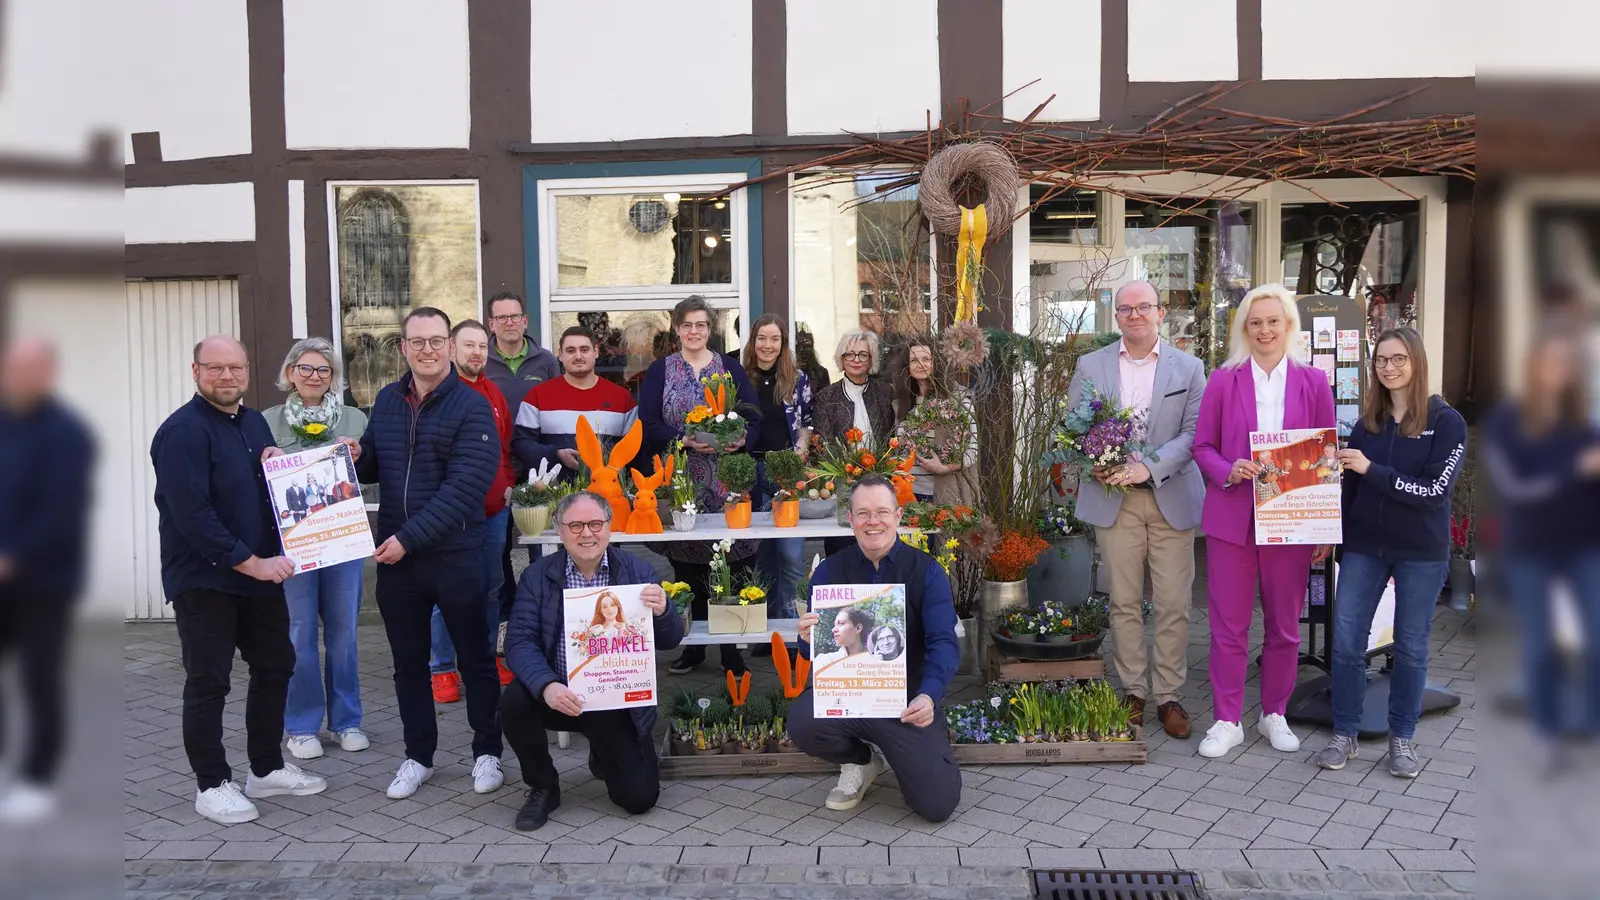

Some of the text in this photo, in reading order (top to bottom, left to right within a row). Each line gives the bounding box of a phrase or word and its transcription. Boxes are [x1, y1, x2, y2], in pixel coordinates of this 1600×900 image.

[1252, 433, 1291, 444] BRAKEL
[265, 455, 306, 472] BRAKEL
[307, 515, 335, 526] Stereo
[336, 507, 364, 519] Naked
[1258, 512, 1290, 520] Dienstag,
[286, 536, 319, 548] Samstag,
[320, 532, 331, 540] 21.
[332, 528, 349, 537] März
[350, 524, 368, 532] 2026
[815, 588, 856, 600] BRAKEL
[588, 635, 649, 655] BRAKEL
[631, 657, 650, 672] auf
[856, 669, 876, 677] Georg
[588, 685, 607, 694] 13.03.
[816, 680, 846, 688] Freitag,
